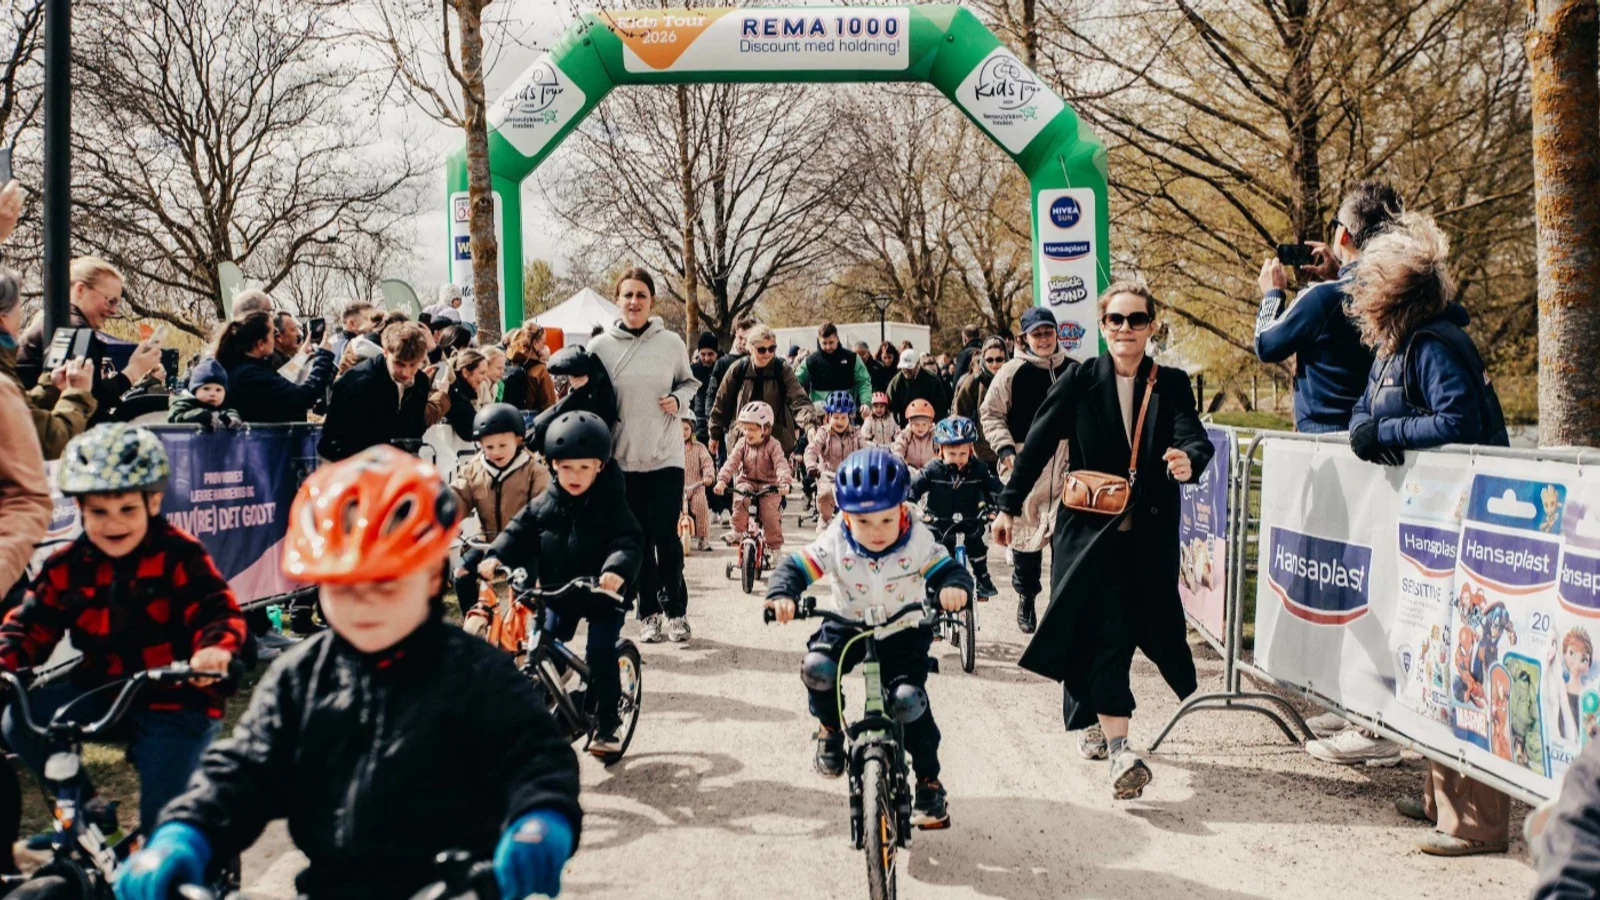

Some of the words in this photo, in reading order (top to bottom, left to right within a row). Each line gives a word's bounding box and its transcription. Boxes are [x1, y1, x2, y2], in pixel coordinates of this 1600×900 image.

[662, 14, 706, 28] Tour
[742, 17, 827, 37] REMA
[836, 17, 900, 37] 1000
[642, 30, 677, 44] 2026
[740, 39, 800, 53] Discount
[804, 39, 835, 52] med
[839, 38, 900, 56] holdning!
[1052, 206, 1080, 215] NIVEA
[1045, 244, 1088, 255] Hansaplast
[1048, 287, 1088, 306] SAND
[219, 506, 242, 531] DET
[1465, 538, 1550, 574] Hansaplast
[1274, 544, 1365, 592] Hansaplast
[1531, 611, 1550, 632] 20
